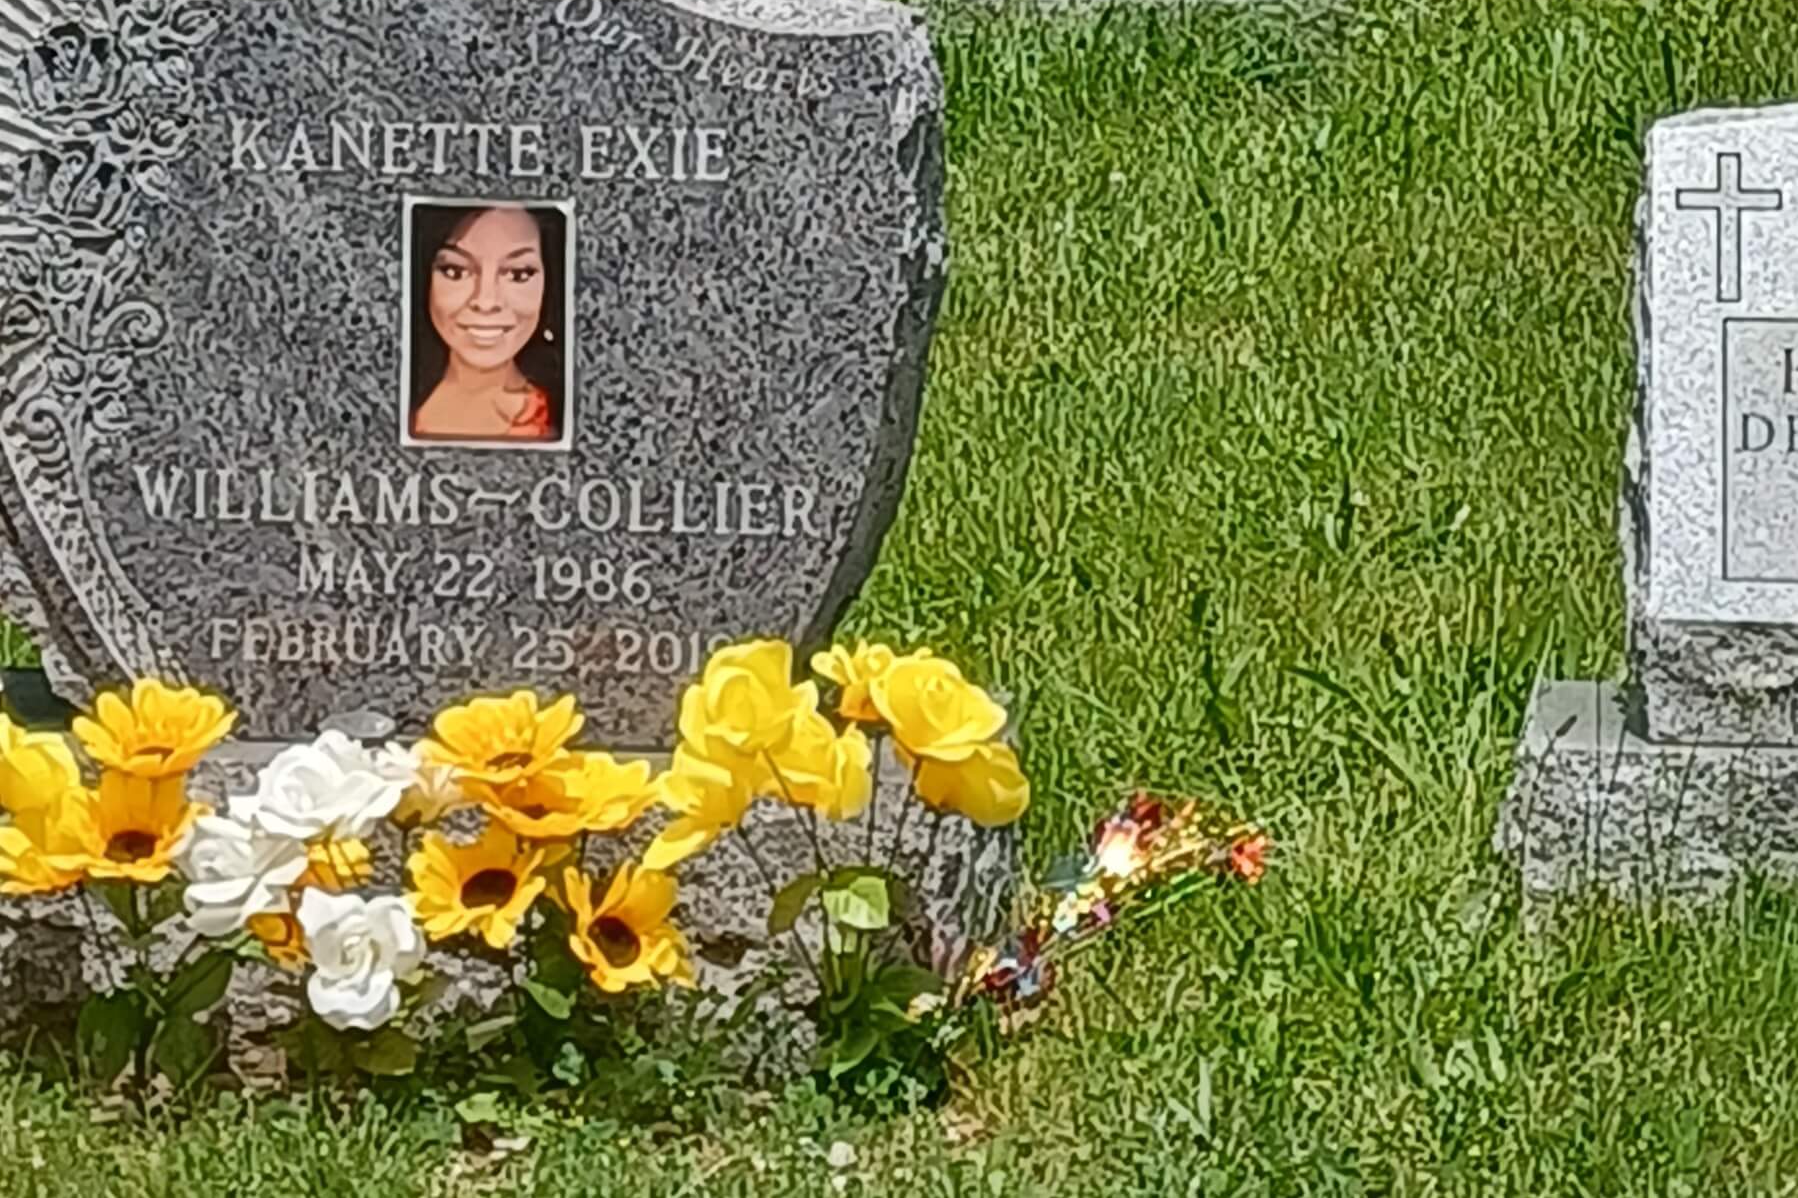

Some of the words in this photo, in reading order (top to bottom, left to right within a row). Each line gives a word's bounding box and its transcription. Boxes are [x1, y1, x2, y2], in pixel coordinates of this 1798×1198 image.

[647, 35, 834, 98] Hearts
[230, 114, 546, 178] KANETTE
[579, 122, 731, 183] EXIE
[297, 548, 410, 596] MAY
[532, 555, 653, 604] 1986
[210, 614, 490, 668] FEBRUARY
